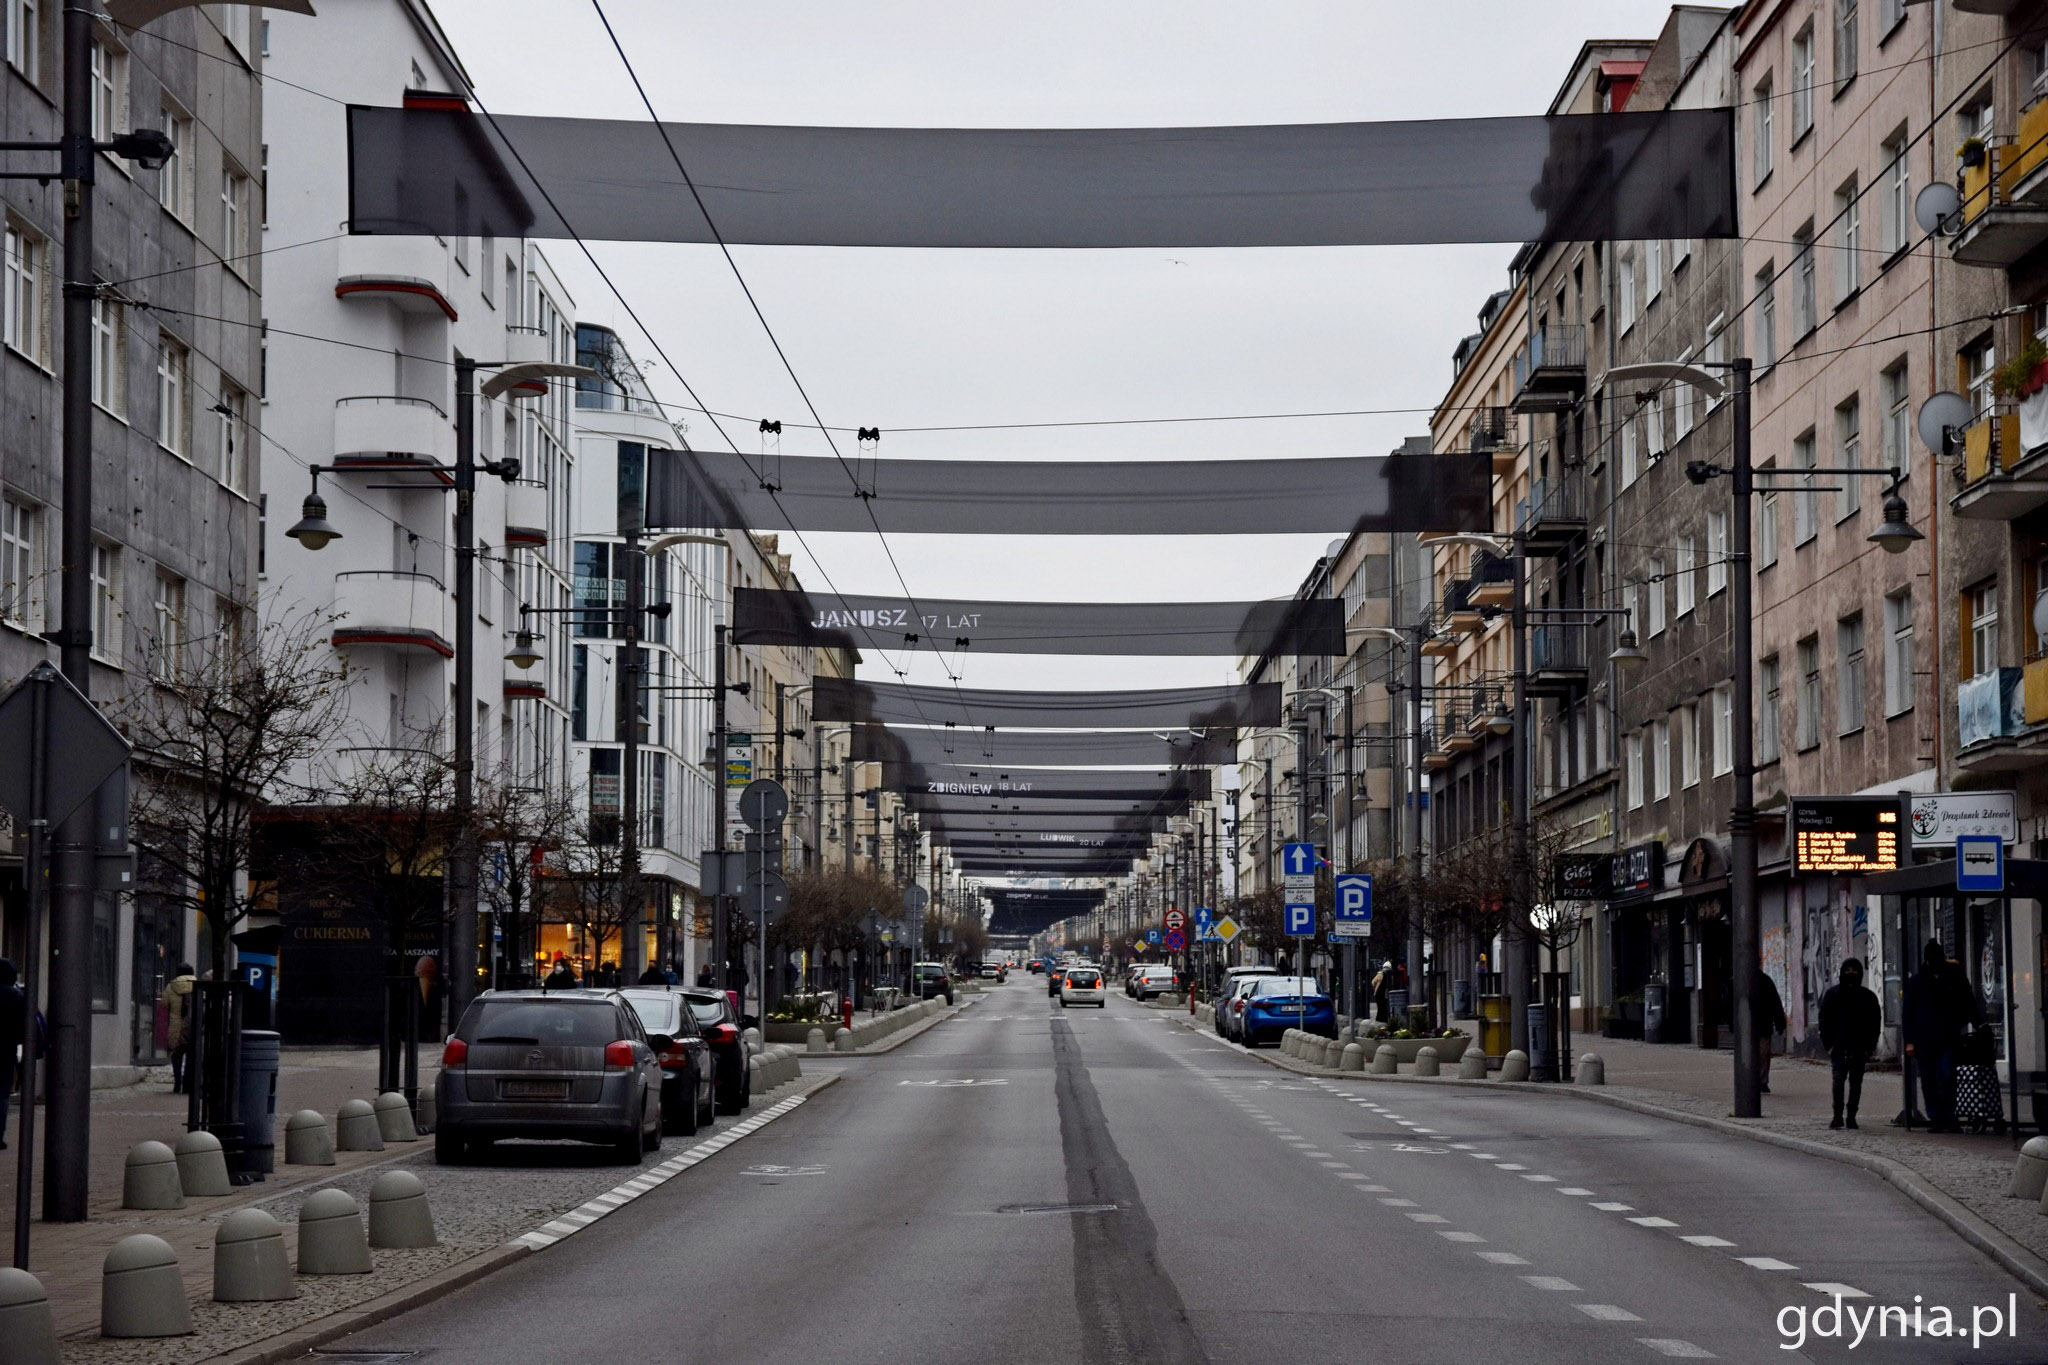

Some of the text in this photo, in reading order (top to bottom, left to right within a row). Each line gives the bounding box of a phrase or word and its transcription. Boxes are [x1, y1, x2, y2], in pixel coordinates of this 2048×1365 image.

[811, 609, 982, 629] JANUSZ 17 LAT
[928, 782, 1032, 794] ZBIGNIEW 18 LAT
[1825, 816, 1833, 824] 02
[1040, 833, 1075, 842] LUDWIK
[1630, 850, 1649, 882] PIZZA
[1344, 889, 1364, 916] P
[1292, 907, 1309, 931] P
[294, 927, 371, 940] CUKIERNIA
[1150, 931, 1157, 942] P
[250, 967, 262, 986] P
